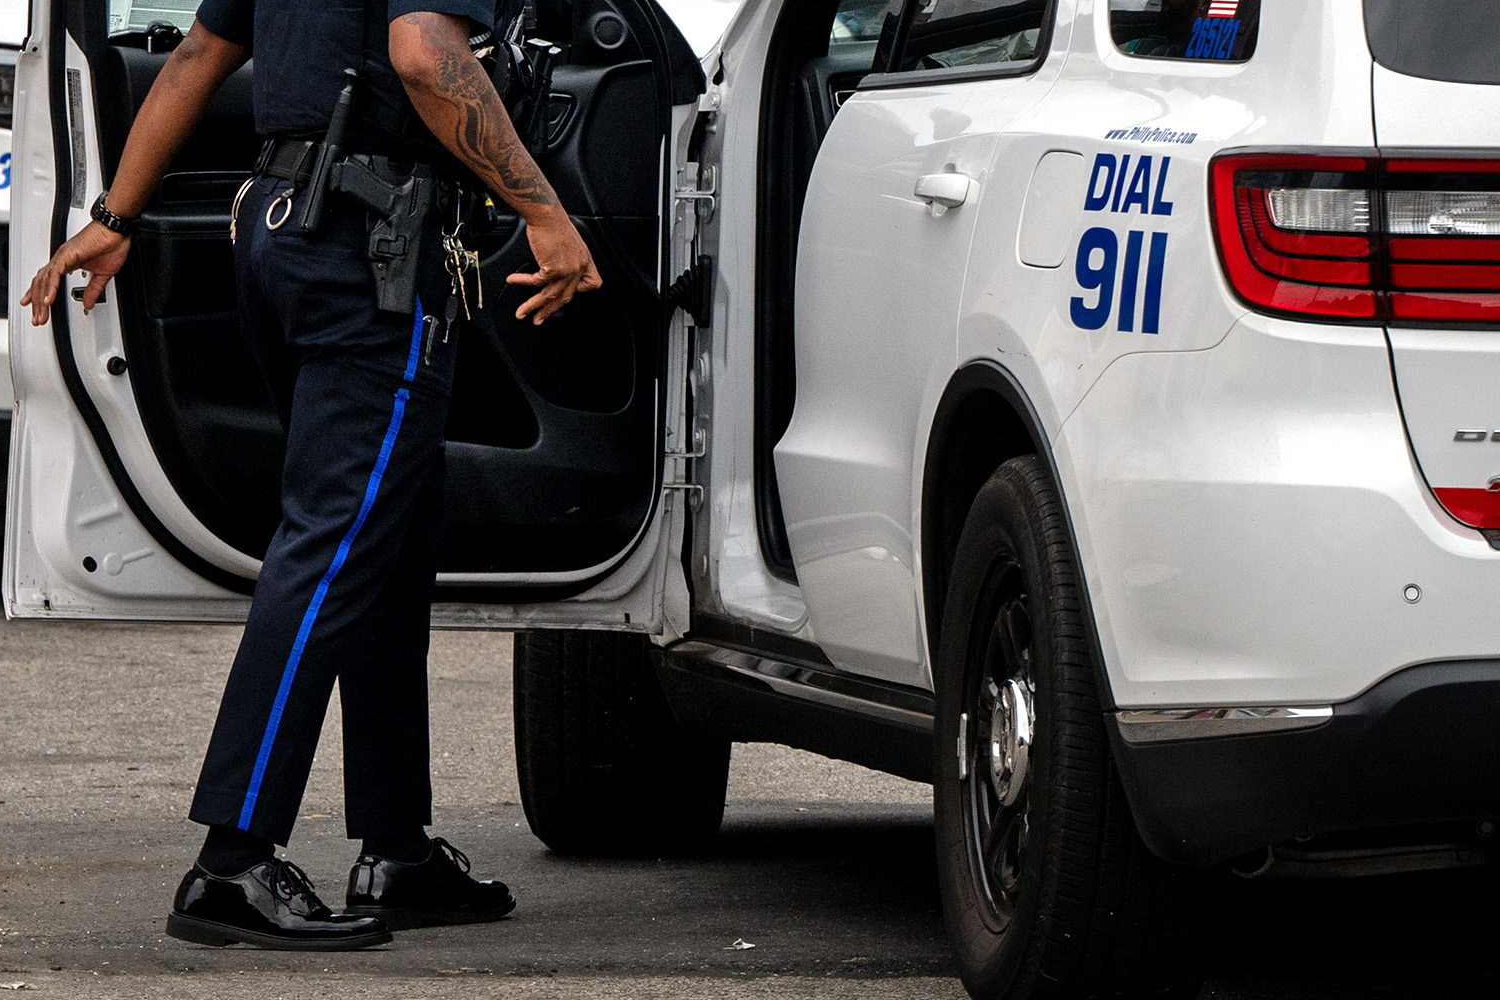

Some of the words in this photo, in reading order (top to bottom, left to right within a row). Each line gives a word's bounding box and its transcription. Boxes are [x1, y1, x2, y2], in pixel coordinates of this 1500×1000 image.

[1185, 17, 1241, 59] 265121
[1104, 127, 1198, 144] www.PhillyPolice.com
[1083, 153, 1173, 216] DIAL
[1070, 226, 1168, 335] 911
